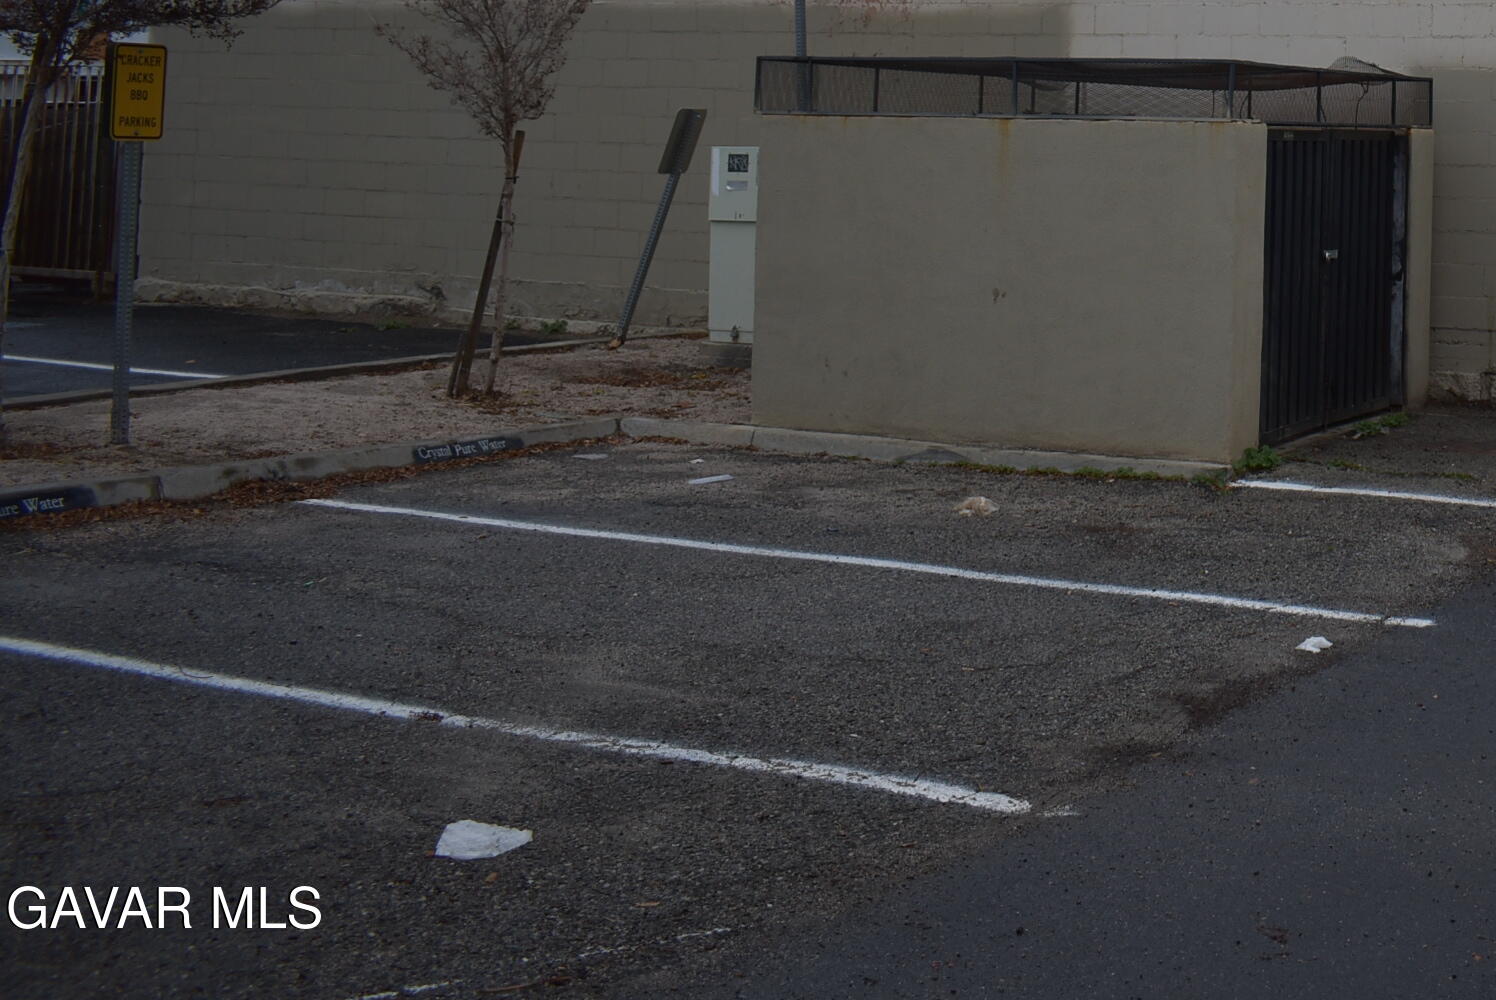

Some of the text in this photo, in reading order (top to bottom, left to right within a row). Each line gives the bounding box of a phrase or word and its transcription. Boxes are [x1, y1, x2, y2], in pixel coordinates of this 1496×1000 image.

[120, 54, 161, 67] CRACKER
[126, 72, 154, 83] JACKS
[129, 89, 148, 101] BBQ
[119, 116, 157, 128] PARKING
[417, 439, 506, 460] Crystal Pure Water
[21, 497, 65, 513] Water
